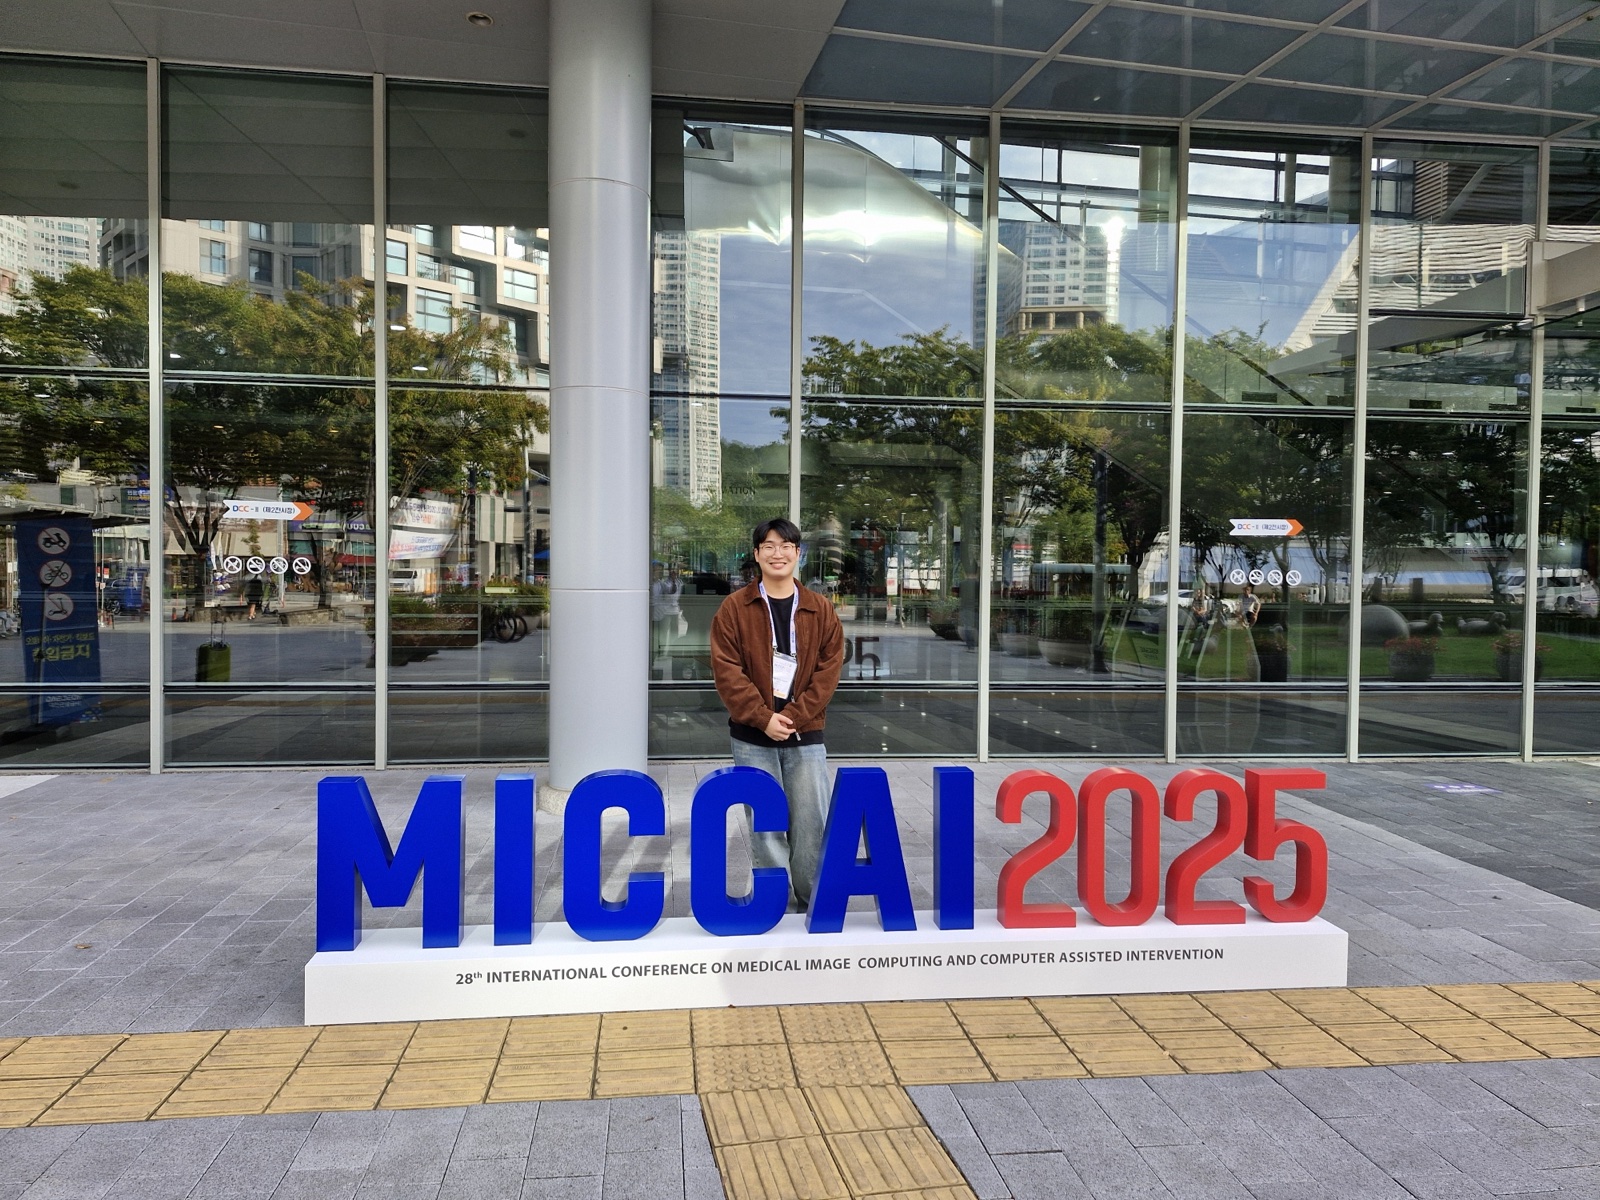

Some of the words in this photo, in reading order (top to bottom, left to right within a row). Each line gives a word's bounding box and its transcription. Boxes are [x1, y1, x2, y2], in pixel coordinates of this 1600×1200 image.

[232, 504, 250, 512] DCC
[316, 766, 974, 951] MICCAI
[996, 766, 1328, 929] 2025
[455, 970, 483, 985] 28th
[486, 966, 607, 984] INTERNATIONAL
[611, 962, 707, 978] CONFERENCE
[711, 961, 733, 975] ON
[737, 959, 801, 974] MEDICAL
[805, 957, 851, 971] IMAGE
[858, 954, 943, 970] COMPUTING
[946, 953, 977, 967] AND
[980, 951, 1056, 966] COMPUTER
[1058, 949, 1123, 964] ASSISTED
[1126, 947, 1225, 962] INTERVENTION
